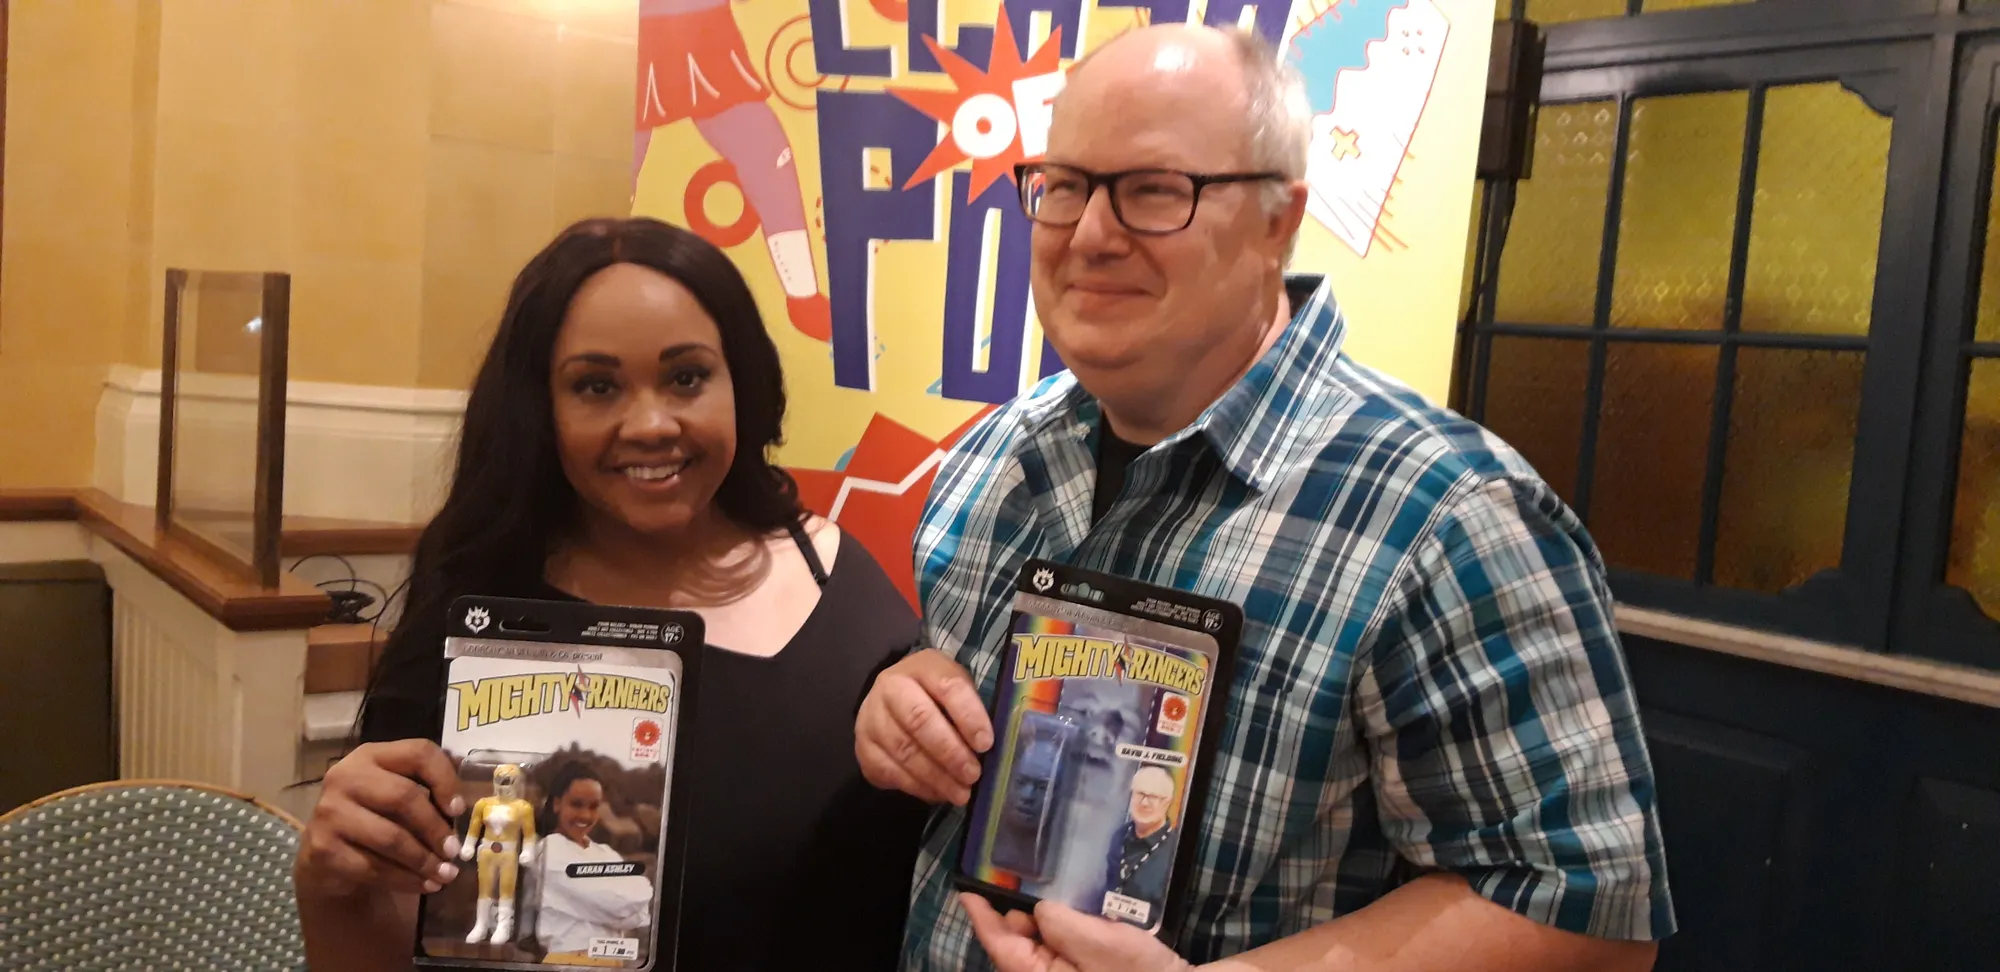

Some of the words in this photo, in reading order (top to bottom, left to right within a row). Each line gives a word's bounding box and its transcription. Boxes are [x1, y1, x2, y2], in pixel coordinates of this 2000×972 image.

[1013, 636, 1123, 680] MIGHTY
[1130, 649, 1204, 694] RANGERS
[449, 672, 576, 732] MIGHTY
[585, 672, 671, 714] RANGERS
[1121, 748, 1143, 758] DAVID
[1151, 753, 1183, 764] FIELDING
[576, 865, 604, 874] KARAN
[604, 864, 635, 873] ASHLEY
